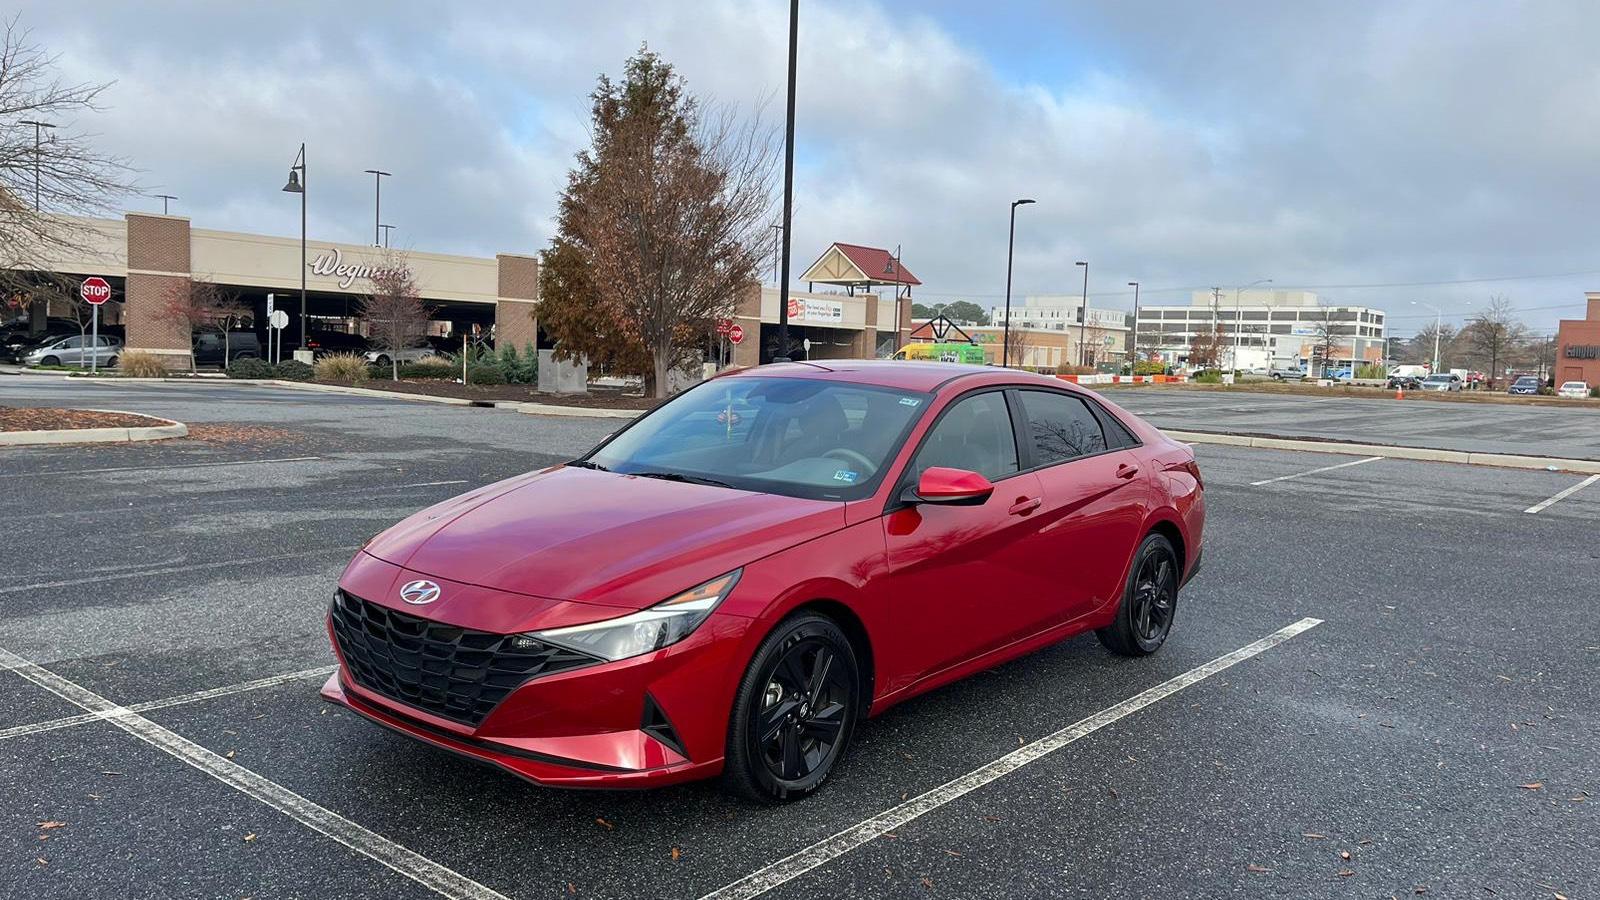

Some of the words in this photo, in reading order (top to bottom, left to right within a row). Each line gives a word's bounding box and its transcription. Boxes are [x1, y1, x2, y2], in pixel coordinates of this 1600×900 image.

[307, 248, 410, 289] Wegms
[83, 285, 108, 297] STOP
[730, 330, 743, 338] STOP
